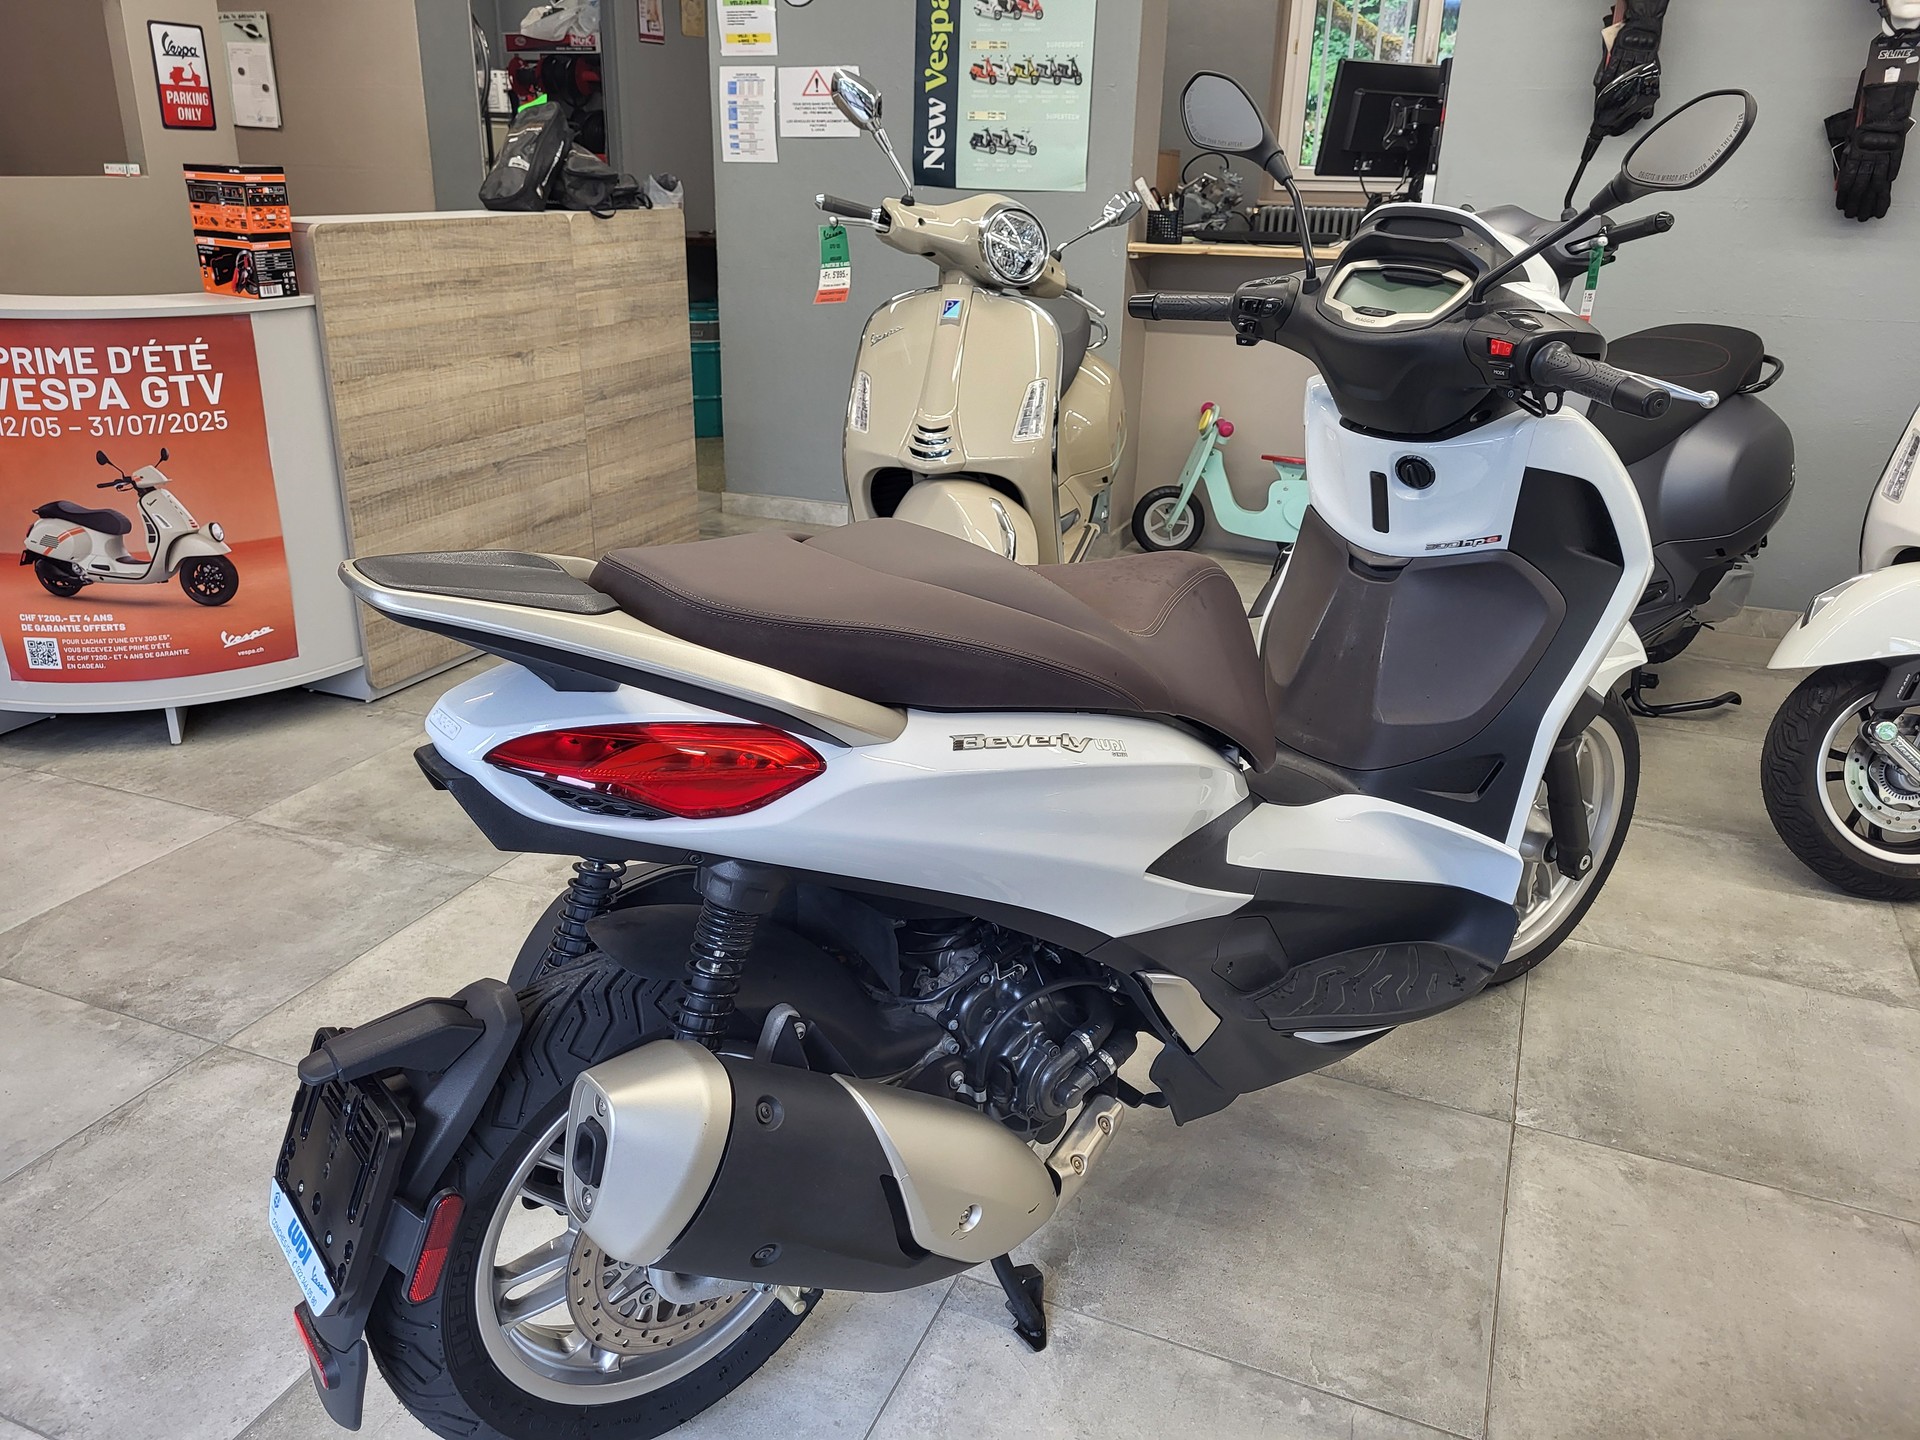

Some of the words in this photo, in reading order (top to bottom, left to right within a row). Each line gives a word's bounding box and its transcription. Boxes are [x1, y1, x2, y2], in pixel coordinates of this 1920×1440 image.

[161, 31, 200, 59] Vespa
[166, 90, 209, 106] PARKING
[177, 107, 202, 121] ONLY
[923, 97, 947, 170] New
[1689, 163, 1708, 179] CLOSER
[1707, 148, 1722, 163] THAN
[1720, 133, 1734, 149] THEY
[107, 337, 213, 374] D'ÉTÉ
[140, 372, 224, 409] GTV
[88, 410, 229, 437] 31/07/2025
[19, 613, 36, 622] CHF
[83, 614, 91, 622] 4
[92, 614, 113, 622] ANS
[21, 623, 34, 632] DE
[34, 624, 81, 633] GARANTIE
[82, 623, 126, 632] OFFERTS
[220, 625, 275, 649] Vespa
[155, 648, 190, 658] GARANTIE
[237, 646, 265, 657] vespa.ch
[950, 733, 1093, 753] Beverly
[287, 1217, 313, 1266] LUDI
[311, 1265, 328, 1297] Vespa
